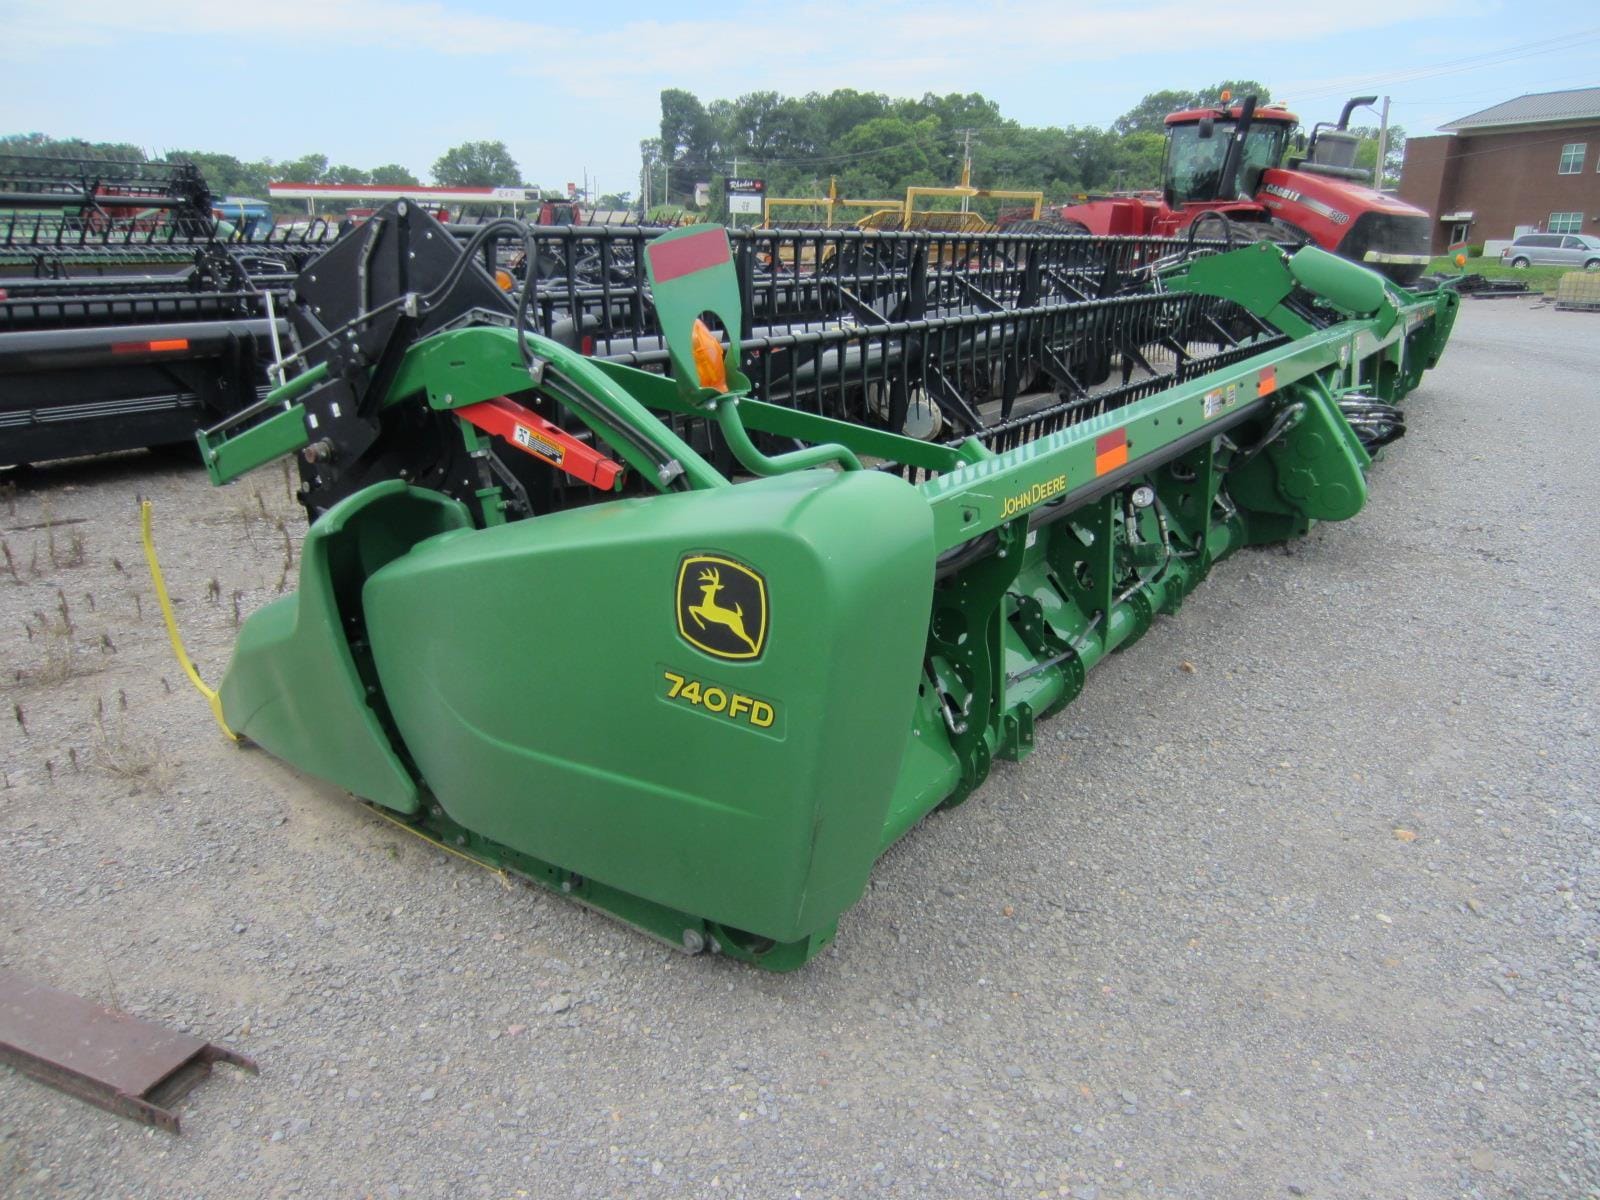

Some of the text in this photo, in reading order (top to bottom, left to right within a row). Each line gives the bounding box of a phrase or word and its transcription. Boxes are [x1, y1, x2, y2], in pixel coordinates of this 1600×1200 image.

[1000, 475, 1066, 519] JOHN DEERE
[664, 671, 775, 728] 740FD
